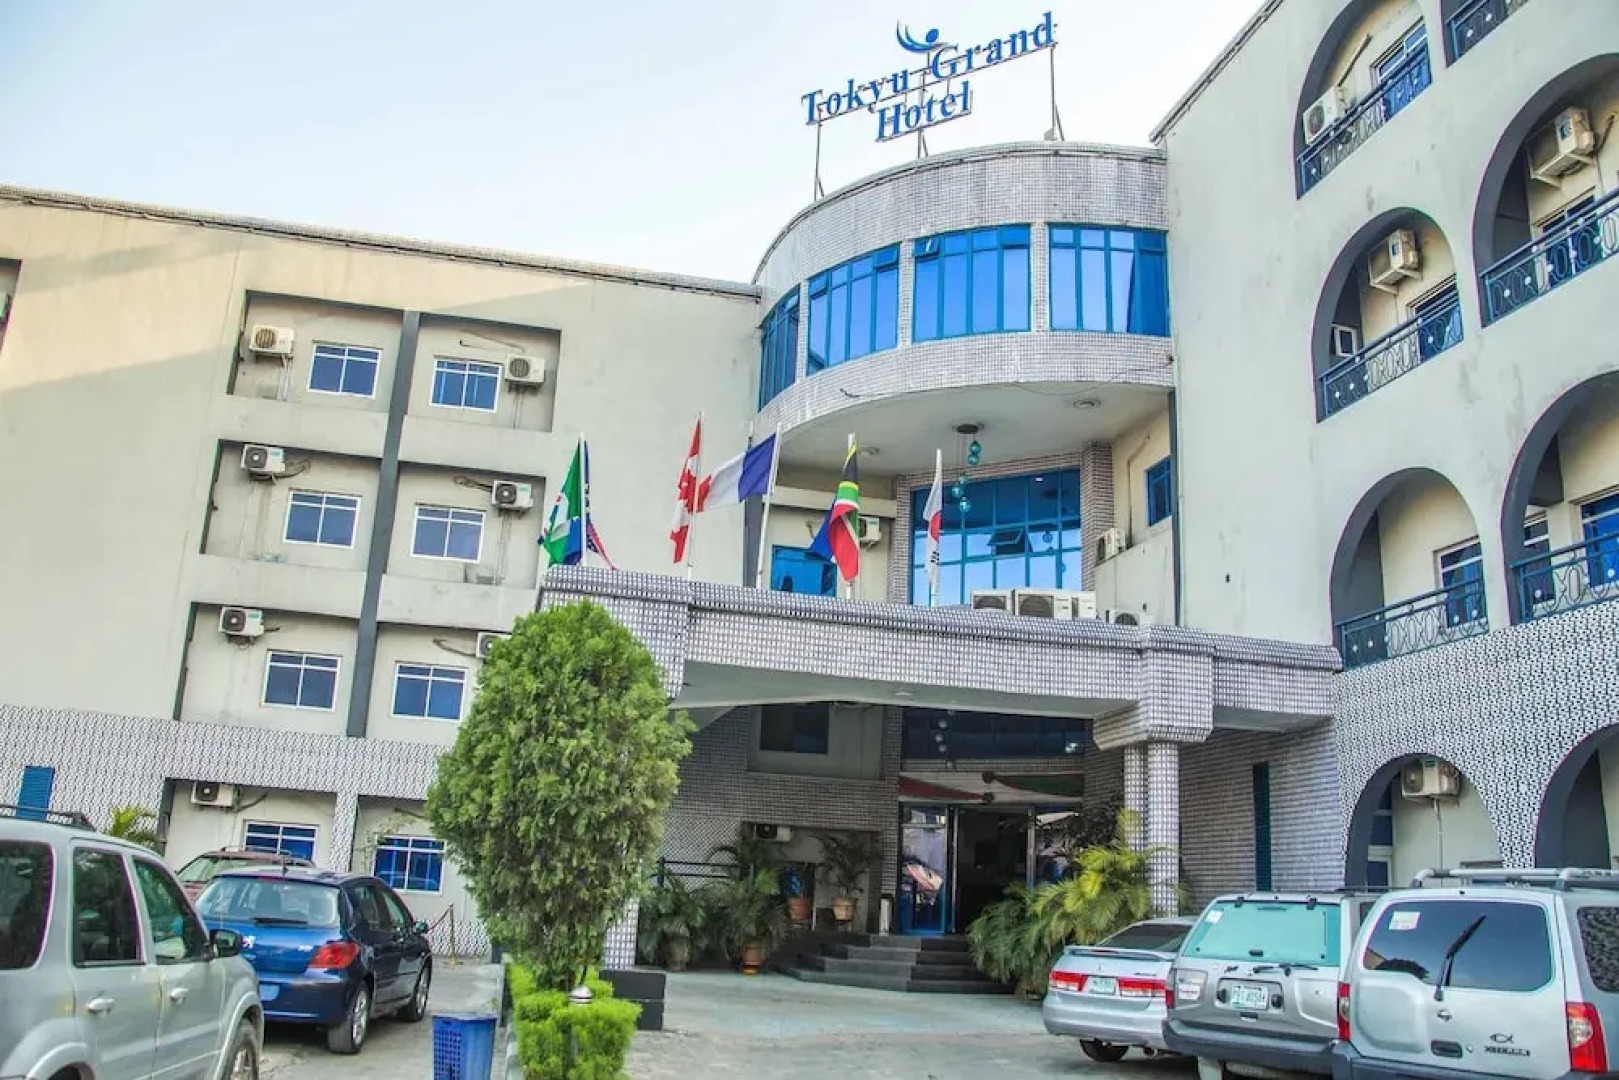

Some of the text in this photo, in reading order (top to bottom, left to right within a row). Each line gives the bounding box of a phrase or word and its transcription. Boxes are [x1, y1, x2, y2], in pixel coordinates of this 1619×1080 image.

[801, 11, 1055, 126] Tokyu Grand
[876, 81, 970, 142] Hotel
